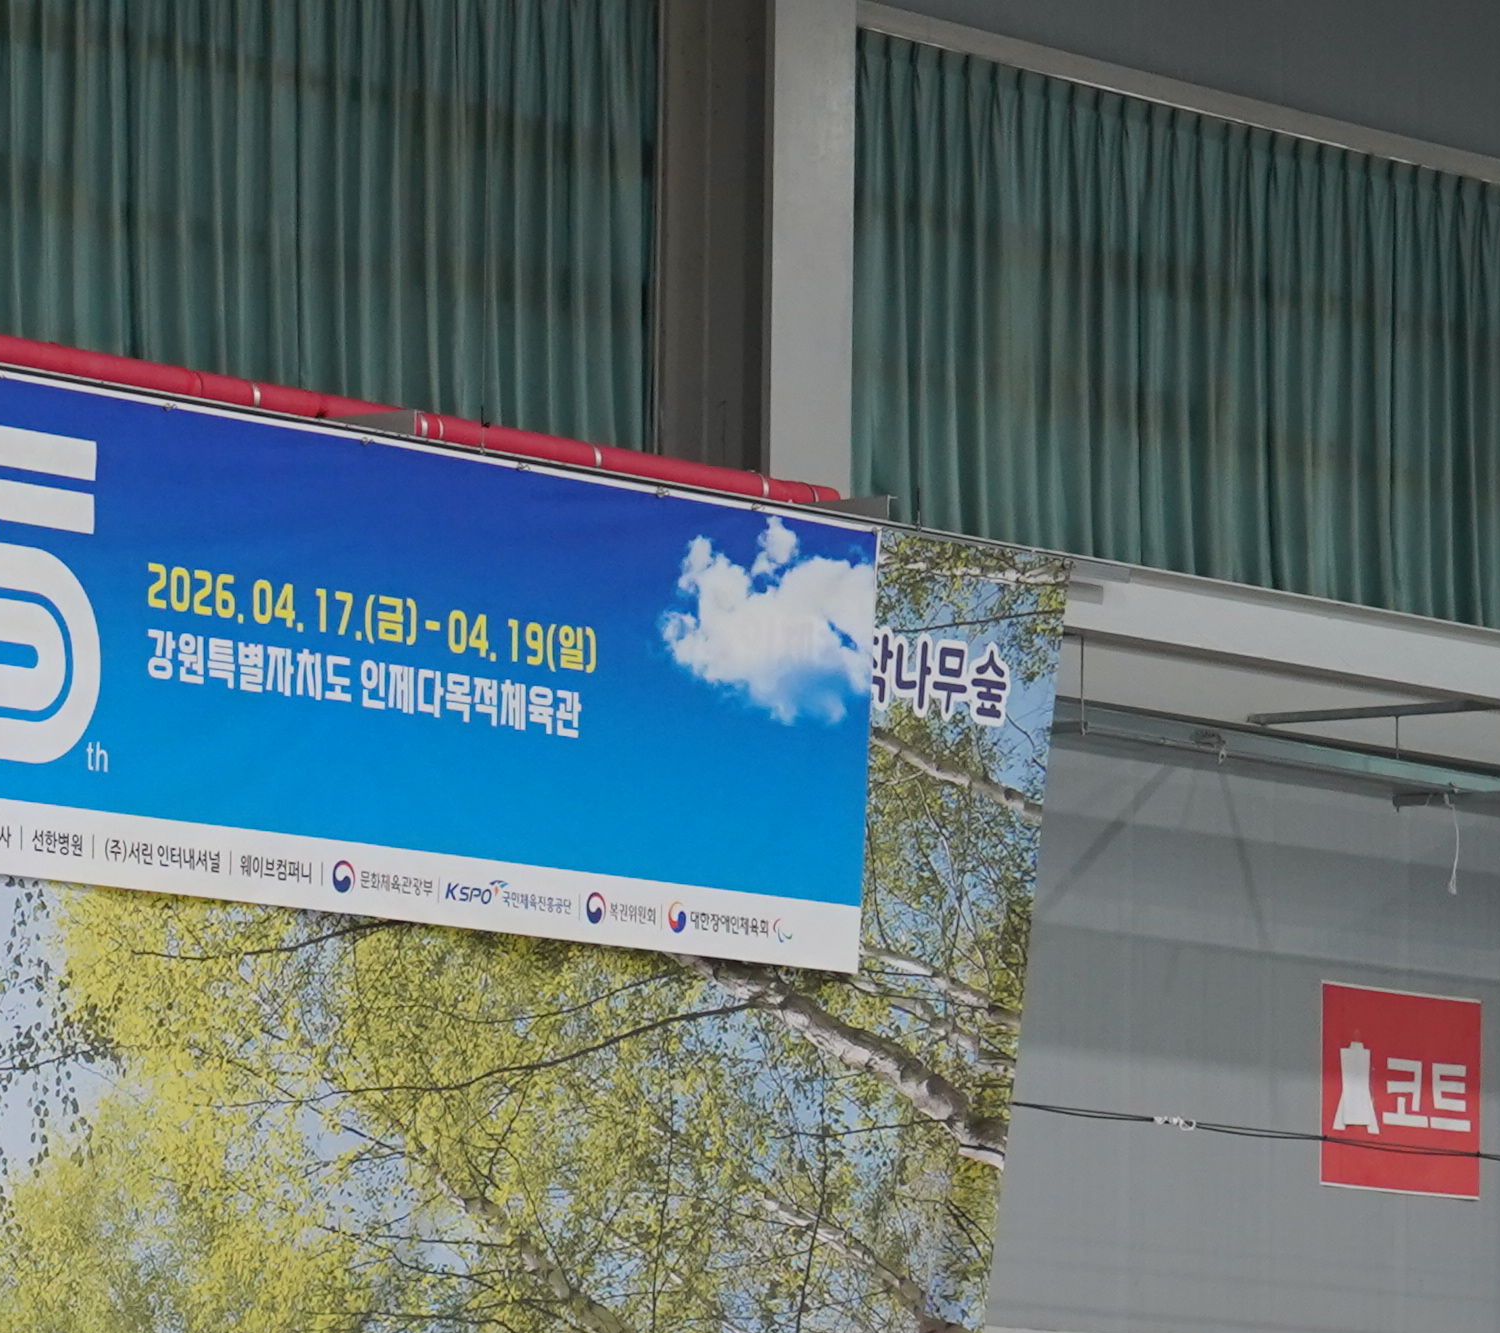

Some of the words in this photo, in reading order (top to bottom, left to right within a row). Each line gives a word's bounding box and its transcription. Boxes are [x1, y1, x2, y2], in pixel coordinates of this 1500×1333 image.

[146, 562, 244, 620] 2026.
[251, 578, 304, 632] 04.
[447, 609, 499, 664] 04.
[506, 614, 597, 675] 19(일)
[146, 629, 353, 704] 강원특별자치도
[360, 655, 583, 739] 인제다목적체육관
[86, 741, 110, 773] th
[31, 829, 84, 858] 선한병원
[104, 837, 154, 867] (주)서린
[156, 844, 221, 875] 인터내셔널
[239, 853, 313, 886] 웨이브컴퍼니
[359, 870, 433, 898] 문화체육관광부
[444, 881, 493, 905] KSPO
[502, 889, 573, 916] 국민체육진흥공단
[609, 902, 657, 926] 복권위원회
[689, 909, 770, 938] 대한장애인체육회
[1383, 1057, 1472, 1133] 코트
